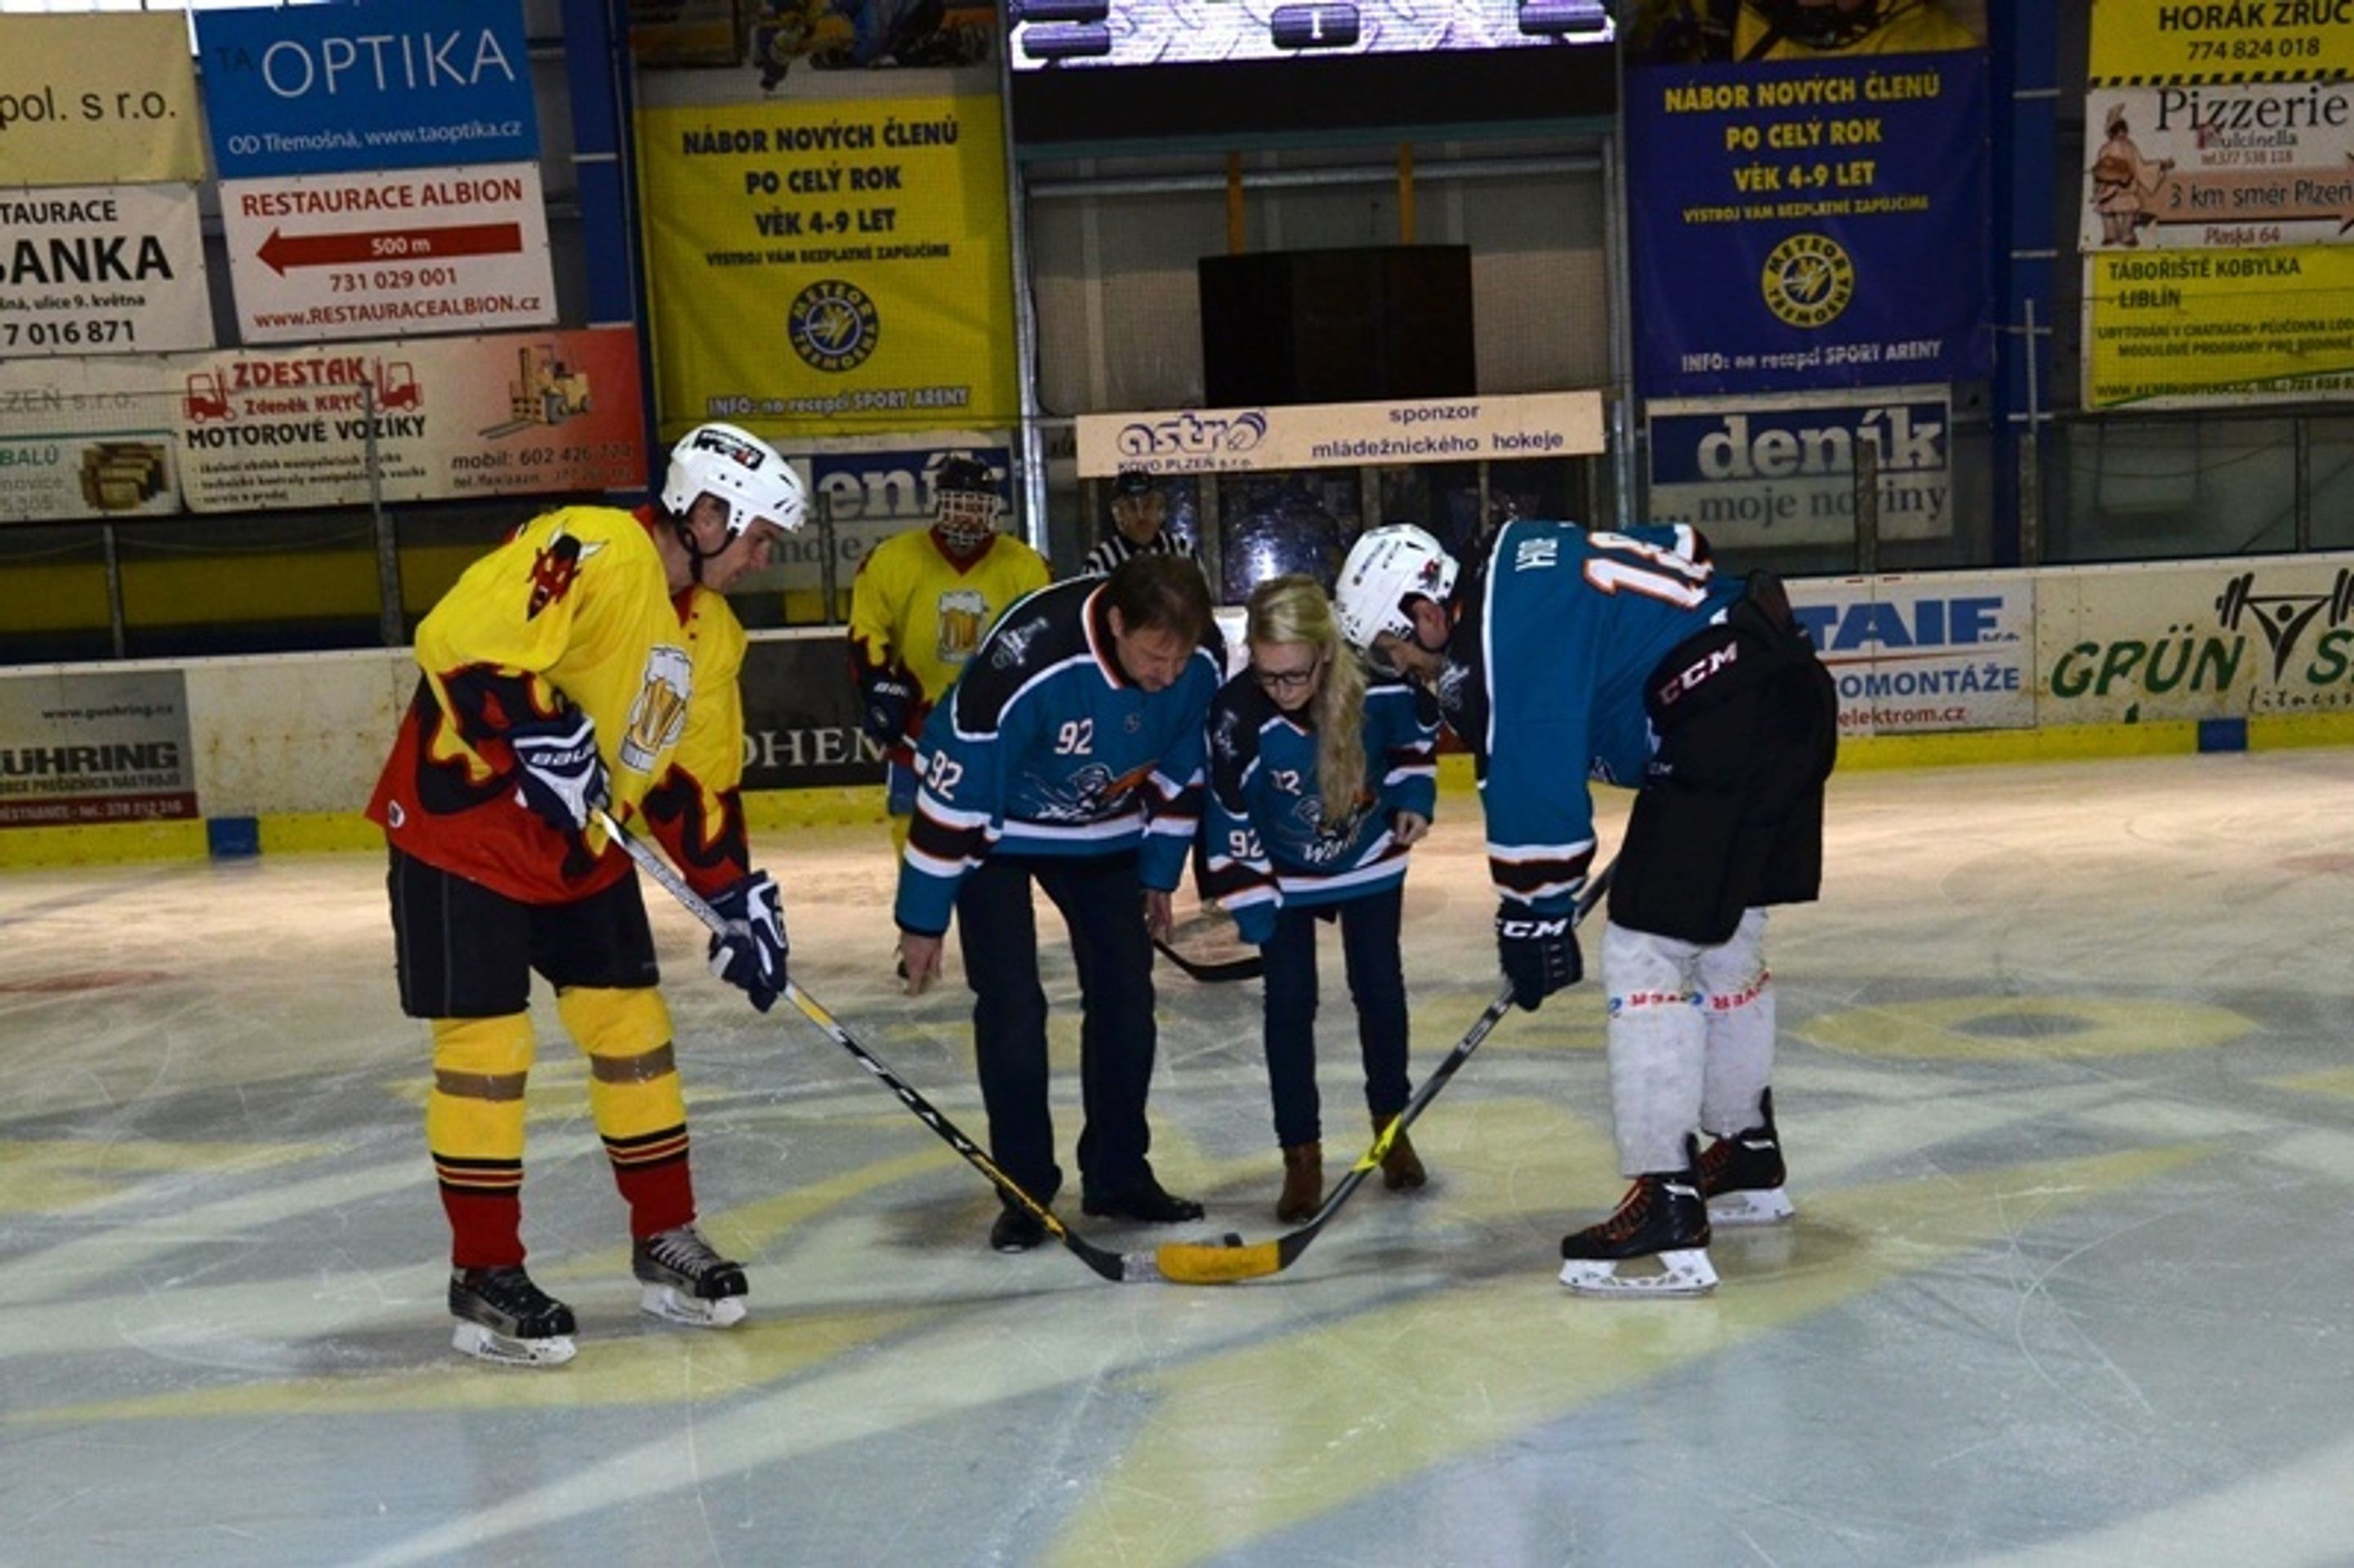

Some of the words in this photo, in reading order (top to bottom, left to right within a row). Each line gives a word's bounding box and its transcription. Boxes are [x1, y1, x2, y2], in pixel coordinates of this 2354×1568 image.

[263, 29, 515, 98] OPTIKA
[2187, 42, 2227, 60] 774
[2232, 39, 2274, 59] 824
[2279, 38, 2321, 57] 018
[82, 93, 103, 120] s
[117, 91, 176, 119] r.o.
[1664, 80, 1750, 112] NÁBOR
[1758, 73, 1856, 107] NOVÝCH
[1865, 68, 1942, 100] ČLENŮ
[2156, 86, 2349, 131] Pizzerie
[229, 136, 259, 155] OD
[364, 121, 523, 147] www.taoptika.cz
[681, 124, 768, 154] NÁBOR
[776, 119, 875, 152] NOVÝCH
[883, 116, 959, 148] ČLENŮ
[1726, 127, 1760, 150] PO
[1768, 116, 1824, 147] CELÝ
[1830, 119, 1882, 145] ROK
[746, 172, 778, 195] PO
[787, 161, 843, 194] CELÝ
[850, 166, 902, 191] ROK
[1732, 162, 1780, 192] VĚK
[1787, 165, 1829, 189] 4-9
[1835, 161, 1875, 186] LET
[241, 185, 412, 216] RESTAURACE
[421, 179, 523, 207] ALBION
[2191, 184, 2224, 204] km
[754, 207, 803, 237] VĚK
[809, 212, 850, 235] 4-9
[858, 209, 896, 234] LET
[371, 238, 408, 256] 500
[412, 240, 431, 253] m
[330, 272, 367, 292] 731
[374, 270, 414, 289] 029
[420, 268, 457, 286] 001
[2216, 256, 2302, 277] KOBYLKA
[253, 294, 541, 328] www.RESTAURACEALBION.cz
[28, 321, 82, 345] 016
[87, 319, 135, 343] 871
[1825, 344, 1880, 365] SPORT
[1884, 340, 1943, 362] ARENY
[853, 390, 907, 409] SPORT
[1389, 403, 1481, 425] sponzor
[187, 419, 328, 449] MOTOROVÉ
[336, 412, 426, 441] VOZÍKY
[1312, 434, 1479, 458] mládežnického
[1492, 430, 1564, 451] hokeje
[1810, 479, 1948, 523] noiny
[1656, 641, 1738, 706] CCM
[1838, 662, 2020, 697] OMONTÁŽE
[1054, 715, 1094, 755] 92
[926, 750, 964, 801] 92
[1228, 827, 1265, 858] 92
